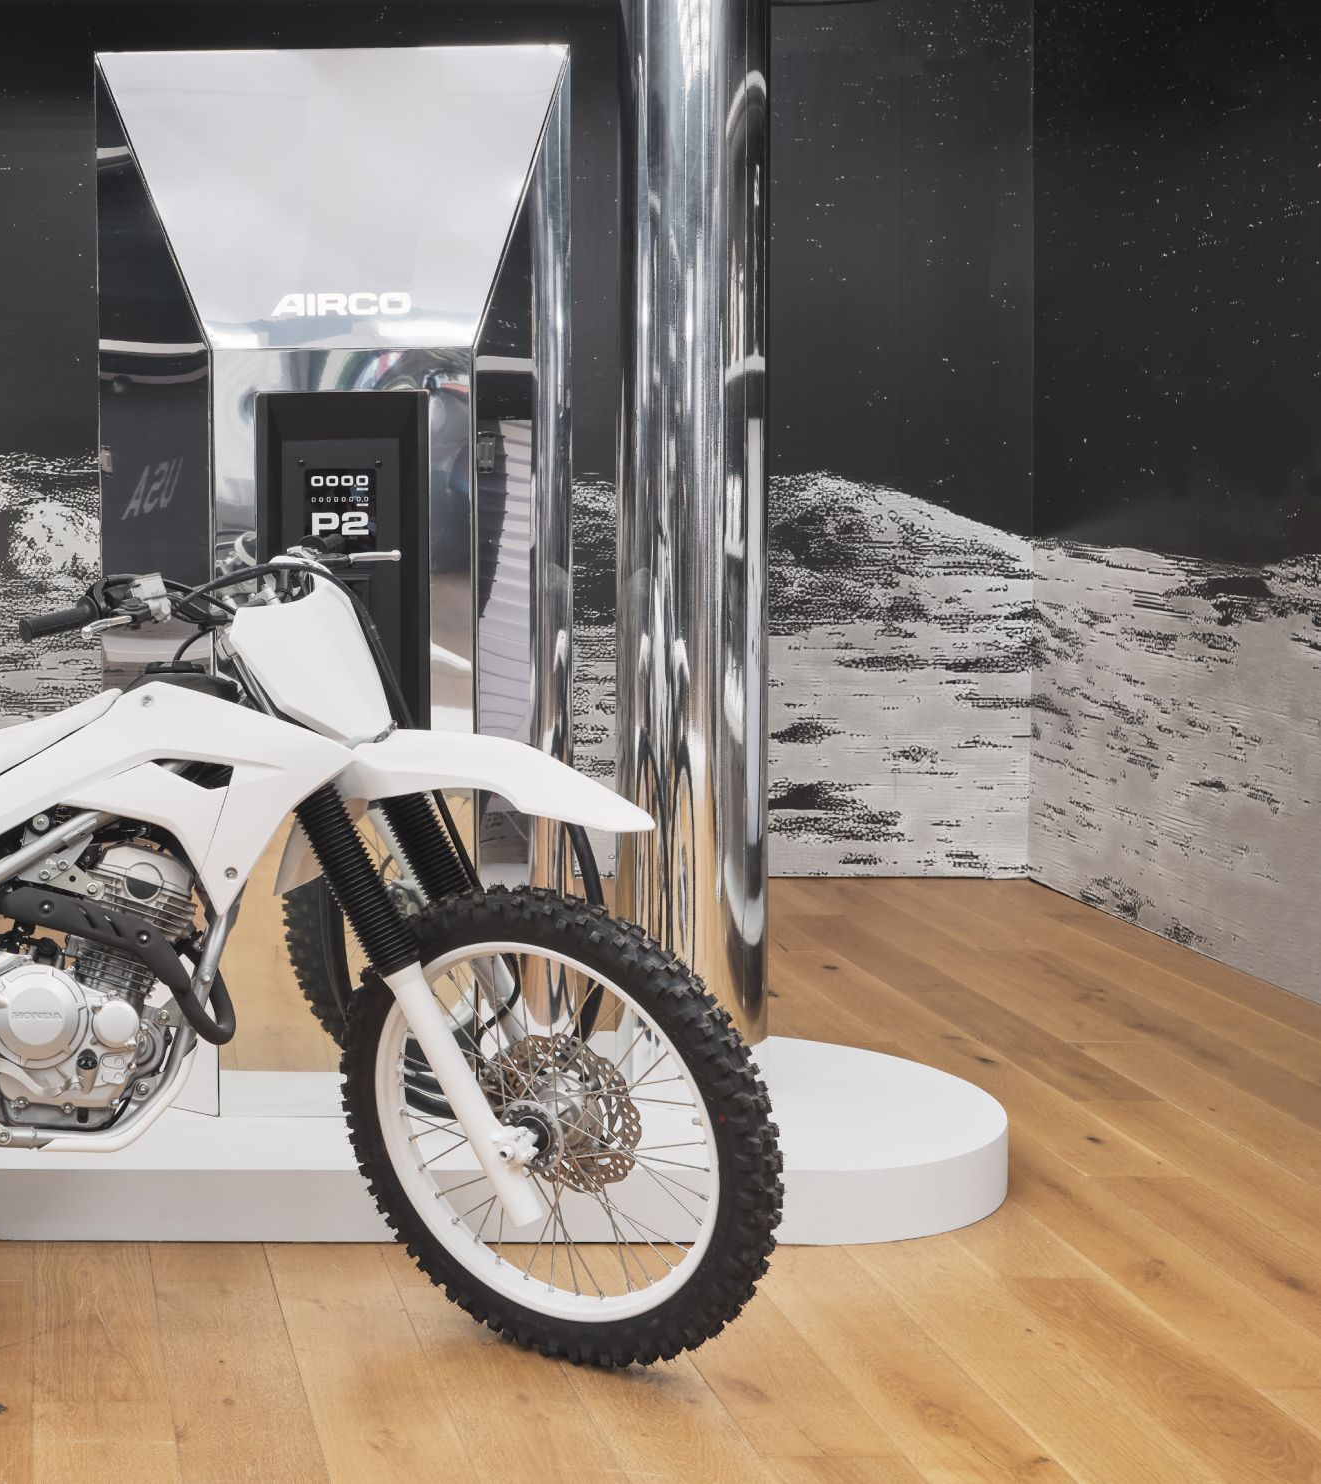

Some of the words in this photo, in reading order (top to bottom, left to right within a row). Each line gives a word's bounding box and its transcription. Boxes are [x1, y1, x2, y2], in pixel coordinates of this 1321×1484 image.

[271, 292, 412, 317] AIRCO
[312, 511, 369, 536] P2
[11, 1010, 63, 1020] HONDA
